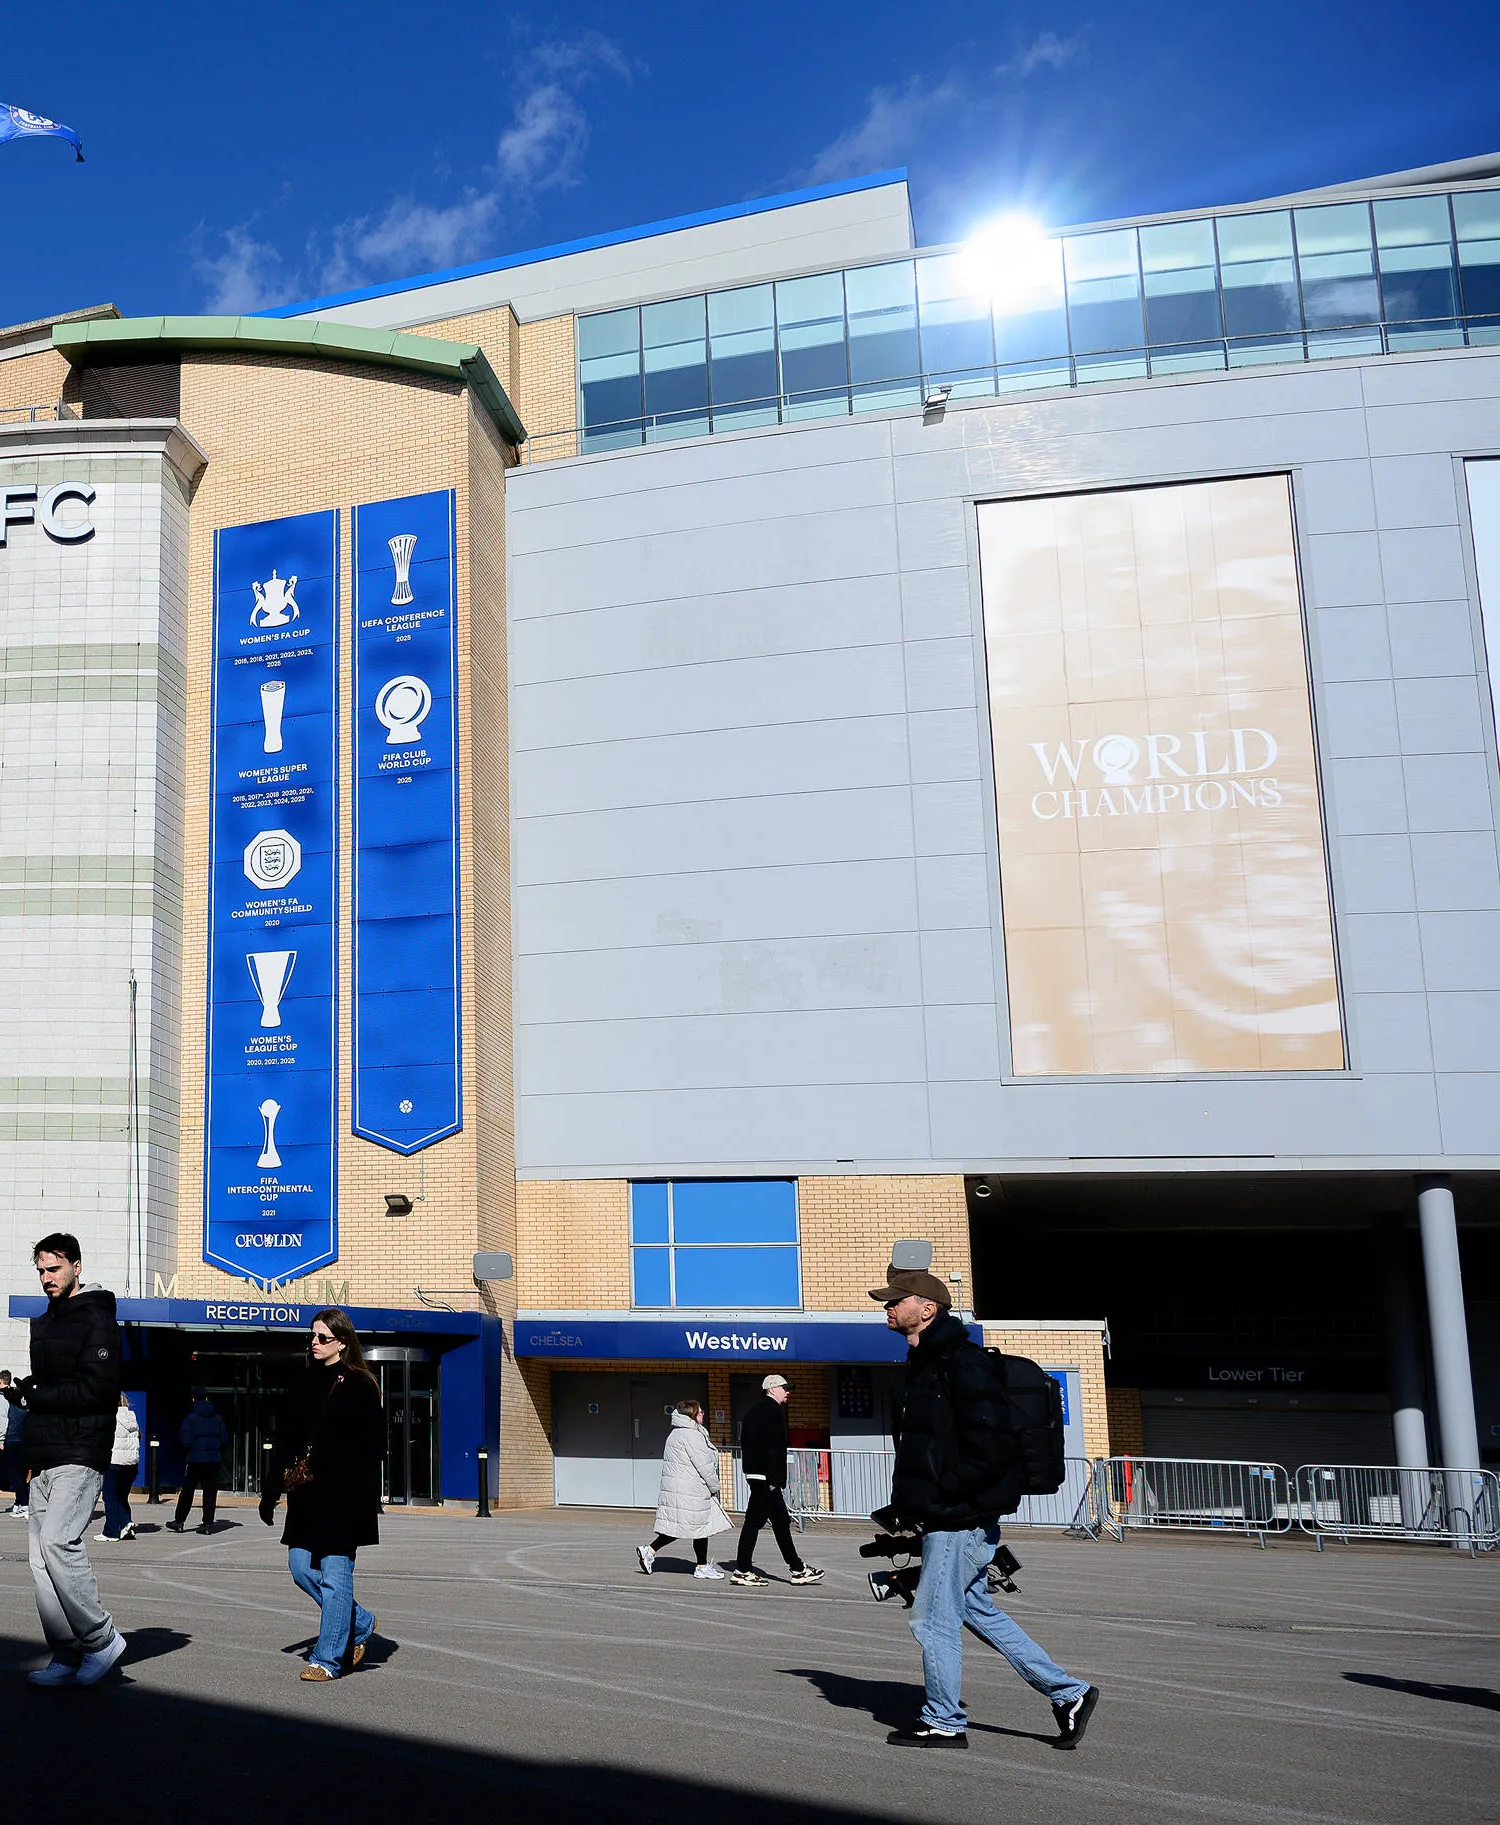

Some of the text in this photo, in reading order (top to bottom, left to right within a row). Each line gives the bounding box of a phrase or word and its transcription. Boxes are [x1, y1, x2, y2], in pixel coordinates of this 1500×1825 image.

[361, 609, 445, 628] UEFA CONFERENCE
[386, 620, 421, 632] LEAGUE
[239, 633, 280, 645] WOMEN'S
[292, 628, 311, 638] CUP
[395, 634, 412, 642] 2025
[383, 749, 427, 761] FIFA CLUB
[1028, 728, 1278, 786] WORLD
[378, 757, 432, 769] WORLD CUP
[238, 763, 308, 778] WOMEN'S SUPER
[257, 773, 290, 784] LEAGUE
[396, 776, 413, 784] 2025
[1031, 777, 1283, 820] CHAMPIONS
[245, 899, 287, 909] WOMEN'S
[231, 904, 313, 918] COMMUNITY SHIELD
[264, 919, 280, 927] 2020
[250, 1035, 292, 1044] WOMEN'S
[244, 1043, 298, 1053] LEAGUE CUP
[260, 1177, 279, 1185] FIFA
[227, 1184, 314, 1194] INTERCONTINENTAL
[259, 1193, 279, 1201] CUP
[235, 1233, 304, 1247] CFC LDN
[153, 1272, 350, 1306] MILLENNIUM
[206, 1305, 300, 1322] RECEPTION
[530, 1335, 583, 1346] CHELSEA
[685, 1331, 789, 1351] Westview
[1208, 1365, 1305, 1382] Lower Tier
